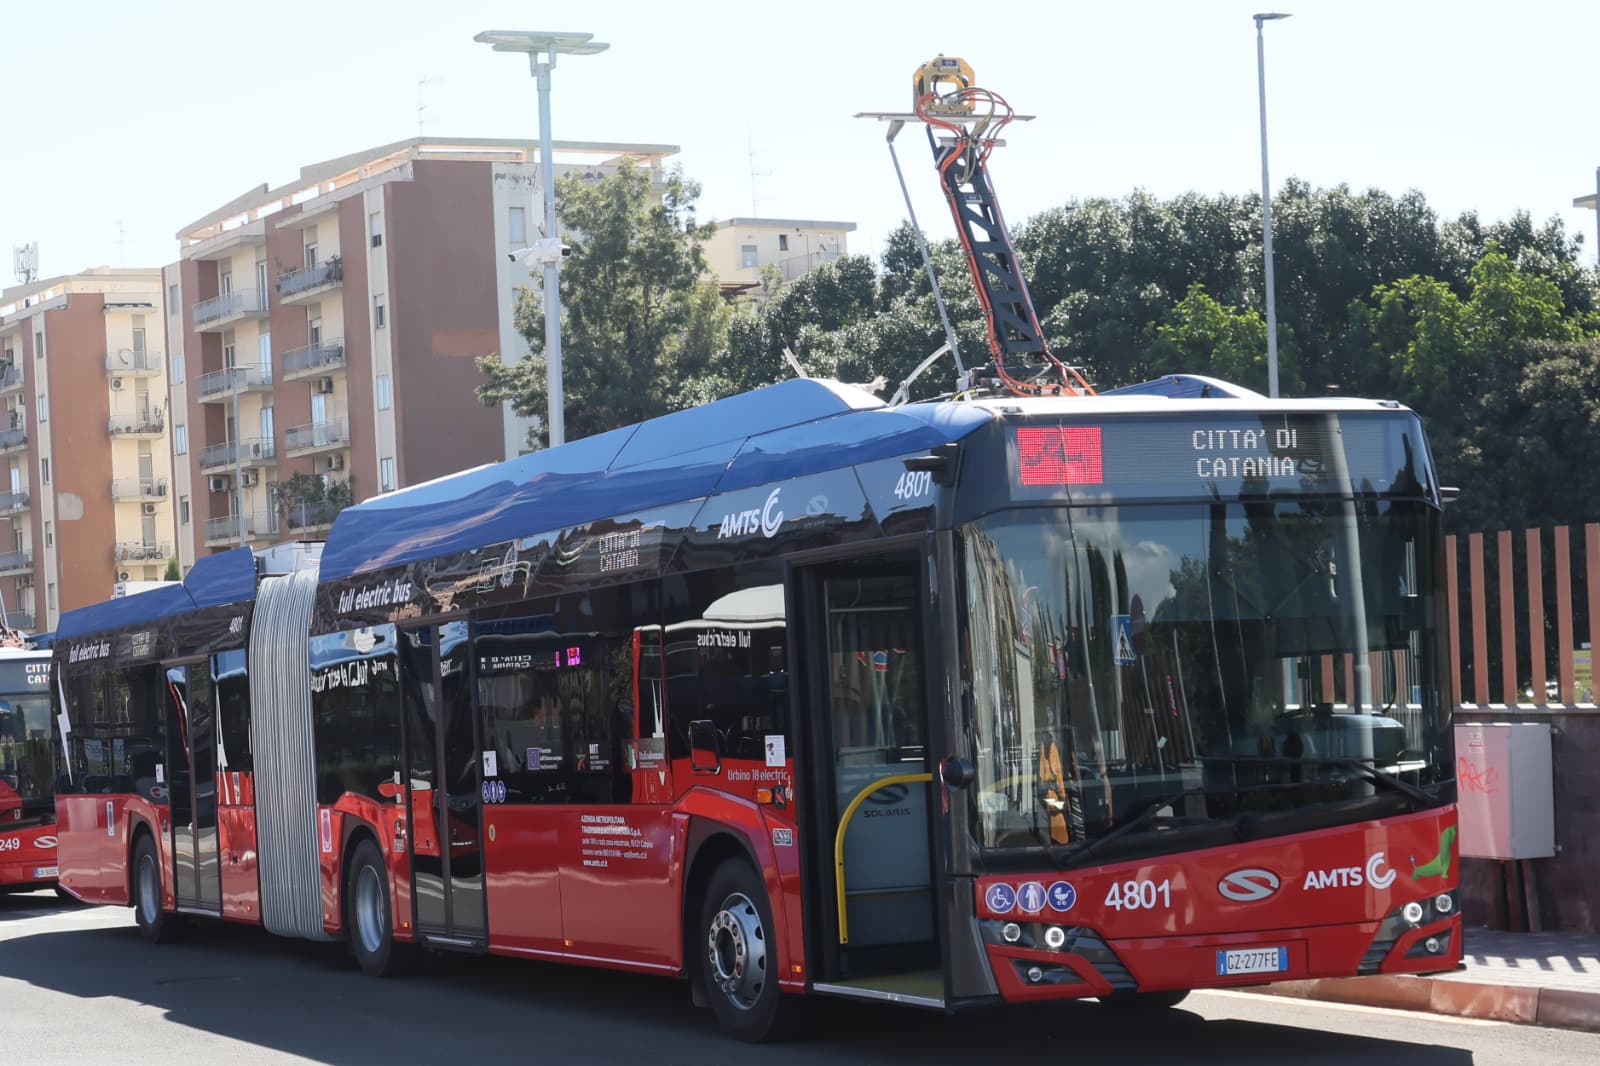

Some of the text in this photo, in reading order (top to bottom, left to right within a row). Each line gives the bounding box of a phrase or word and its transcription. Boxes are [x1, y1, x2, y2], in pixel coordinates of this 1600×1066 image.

[1192, 428, 1298, 450] CITTA' DI
[1197, 456, 1295, 478] CATANIA
[895, 471, 931, 499] 4801
[717, 509, 760, 539] AMTS
[338, 578, 412, 614] full electric bus
[79, 641, 98, 662] electric
[99, 641, 111, 658] bus
[727, 769, 787, 781] Urbino 18 electric
[863, 807, 912, 818] SOLARIS
[1303, 866, 1363, 891] AMTS
[1104, 879, 1171, 911] 4801
